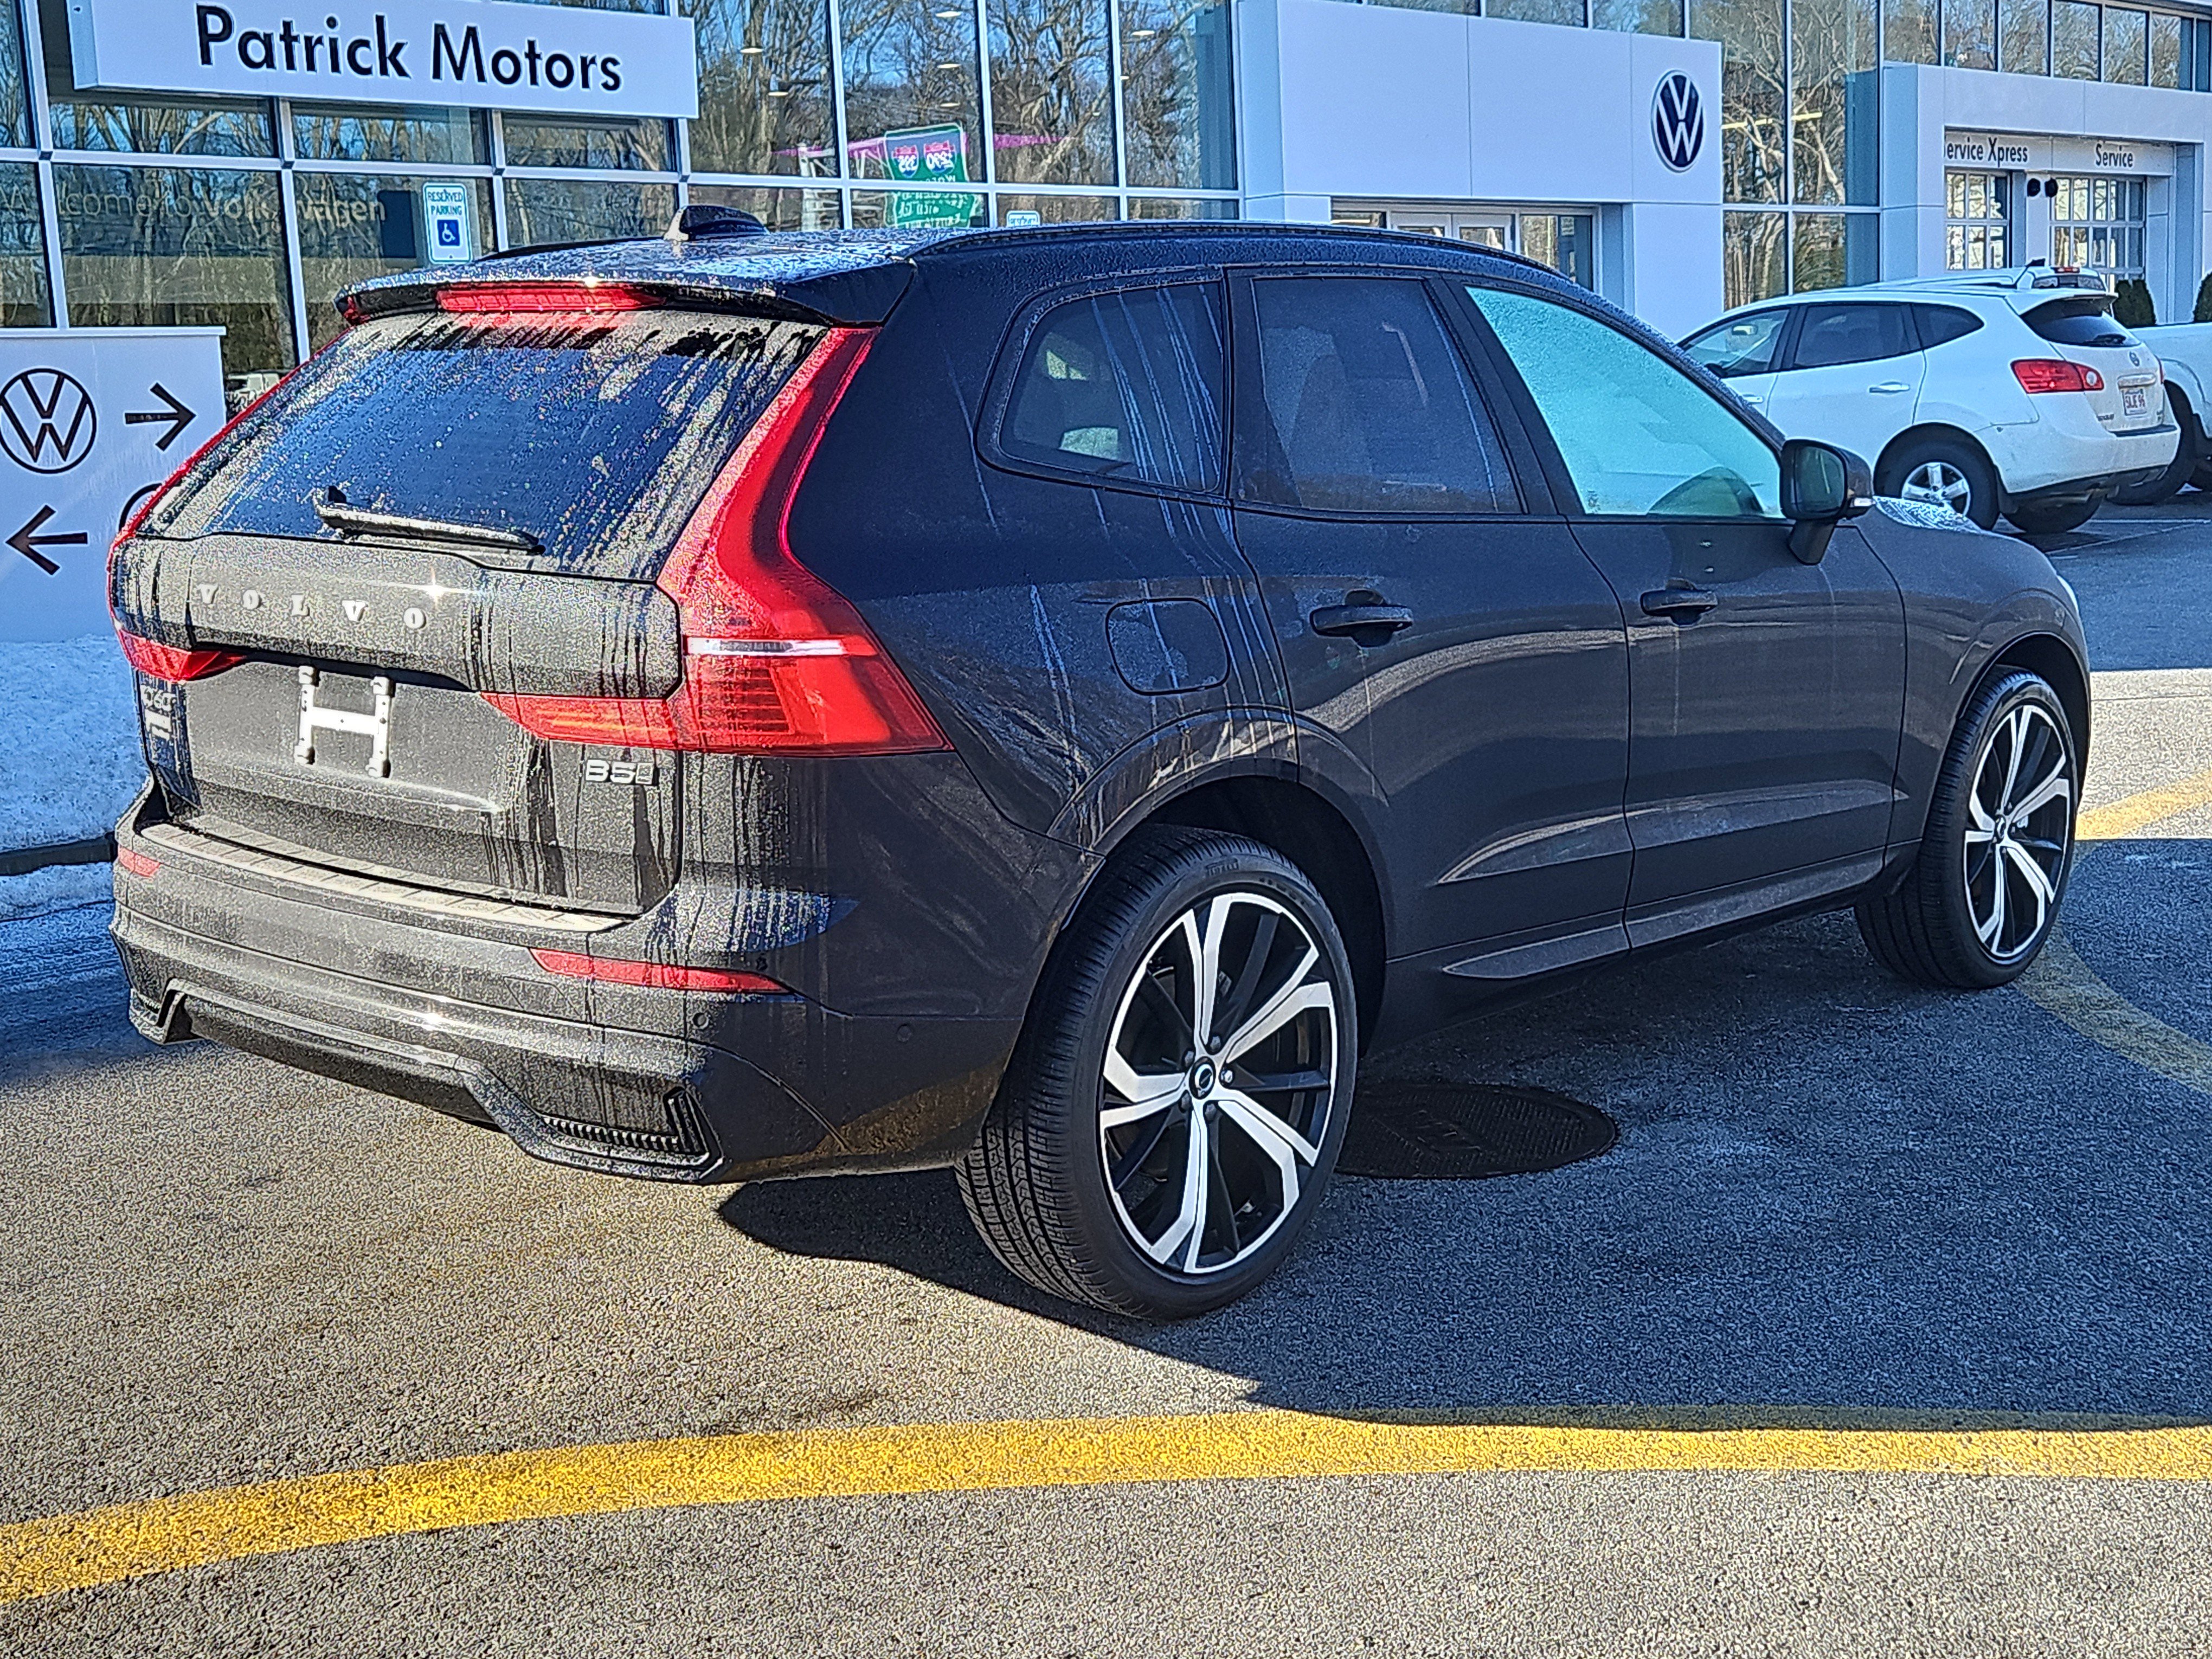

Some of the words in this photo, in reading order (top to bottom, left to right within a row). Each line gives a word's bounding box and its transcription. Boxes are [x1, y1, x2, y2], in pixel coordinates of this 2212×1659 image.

[197, 4, 411, 79] Patrick
[432, 23, 622, 92] Motors
[1944, 137, 1984, 160] ervice
[1988, 137, 2028, 167] Xpress
[2095, 143, 2133, 168] Service
[428, 191, 464, 202] RESERVED
[430, 205, 462, 216] PARKING
[197, 583, 426, 629] VOLVO
